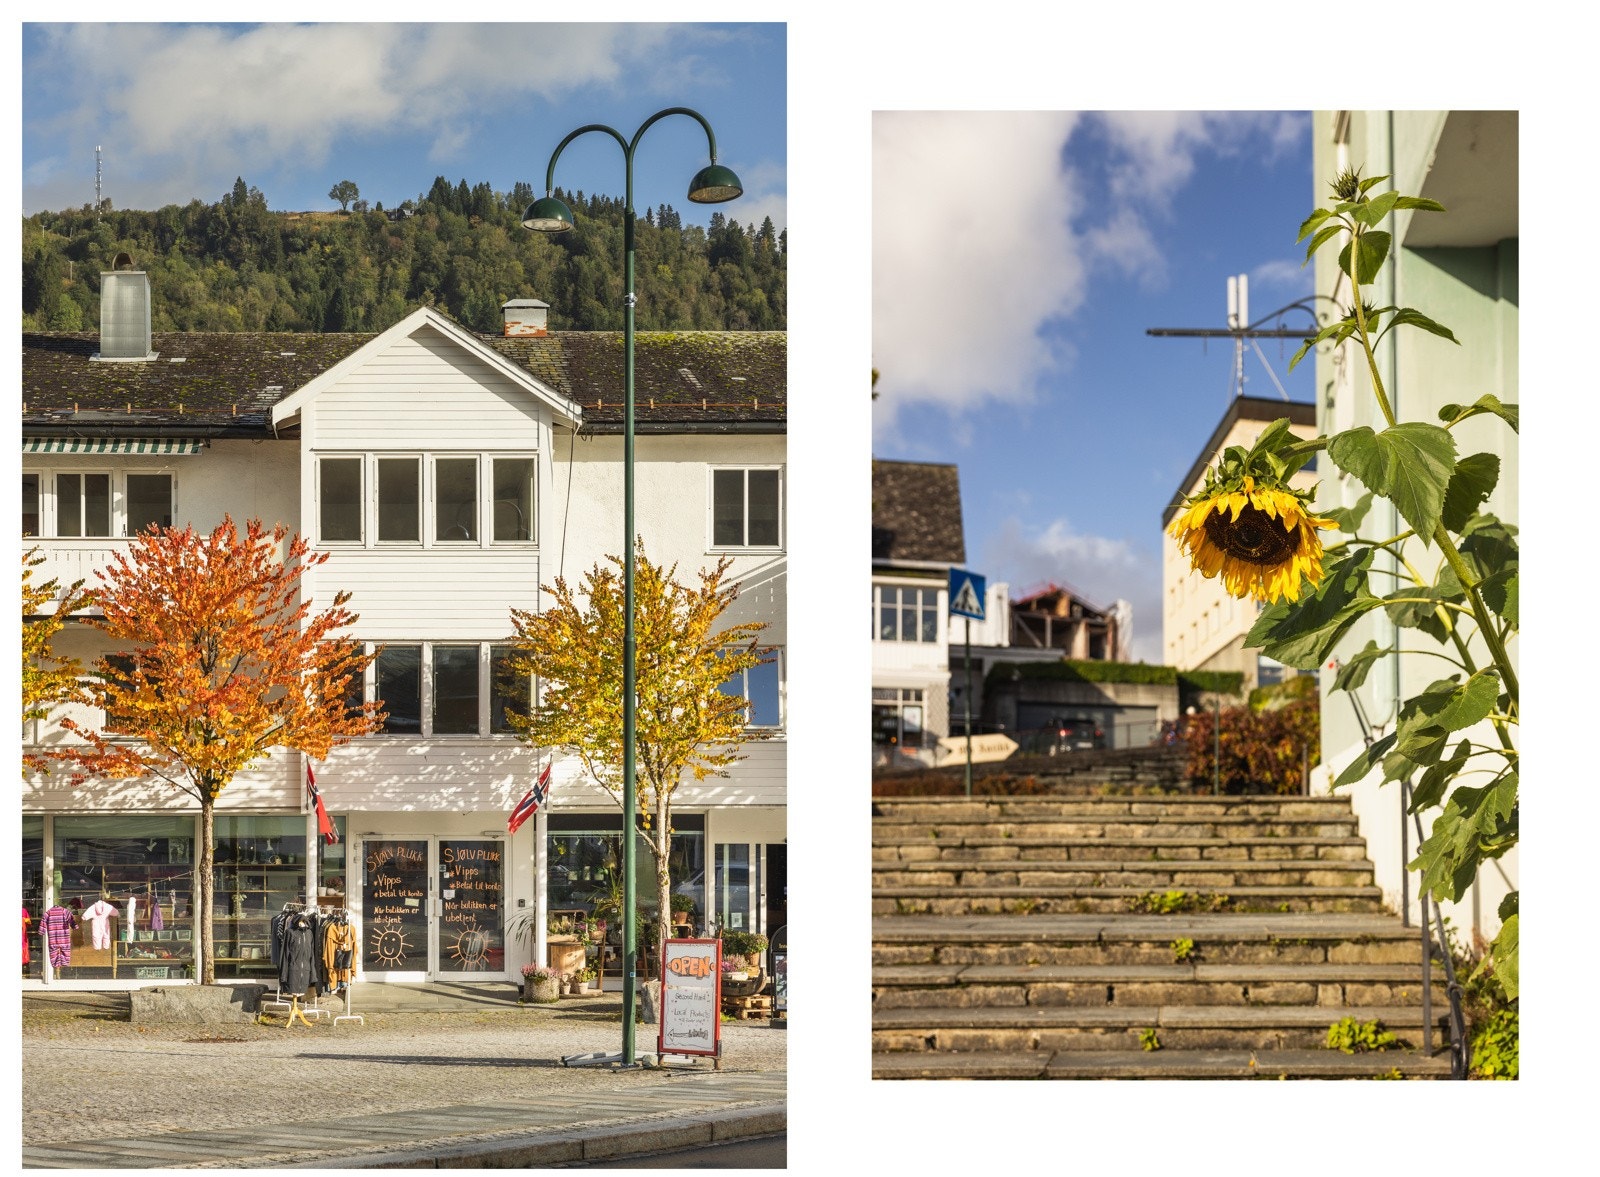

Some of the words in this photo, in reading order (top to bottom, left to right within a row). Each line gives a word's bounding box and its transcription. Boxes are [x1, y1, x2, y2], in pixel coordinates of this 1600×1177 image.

[455, 865, 479, 880] Vipps
[377, 874, 401, 890] Vipps
[461, 900, 487, 909] butikken
[446, 912, 477, 925] ubetjent
[671, 956, 710, 979] OPEN
